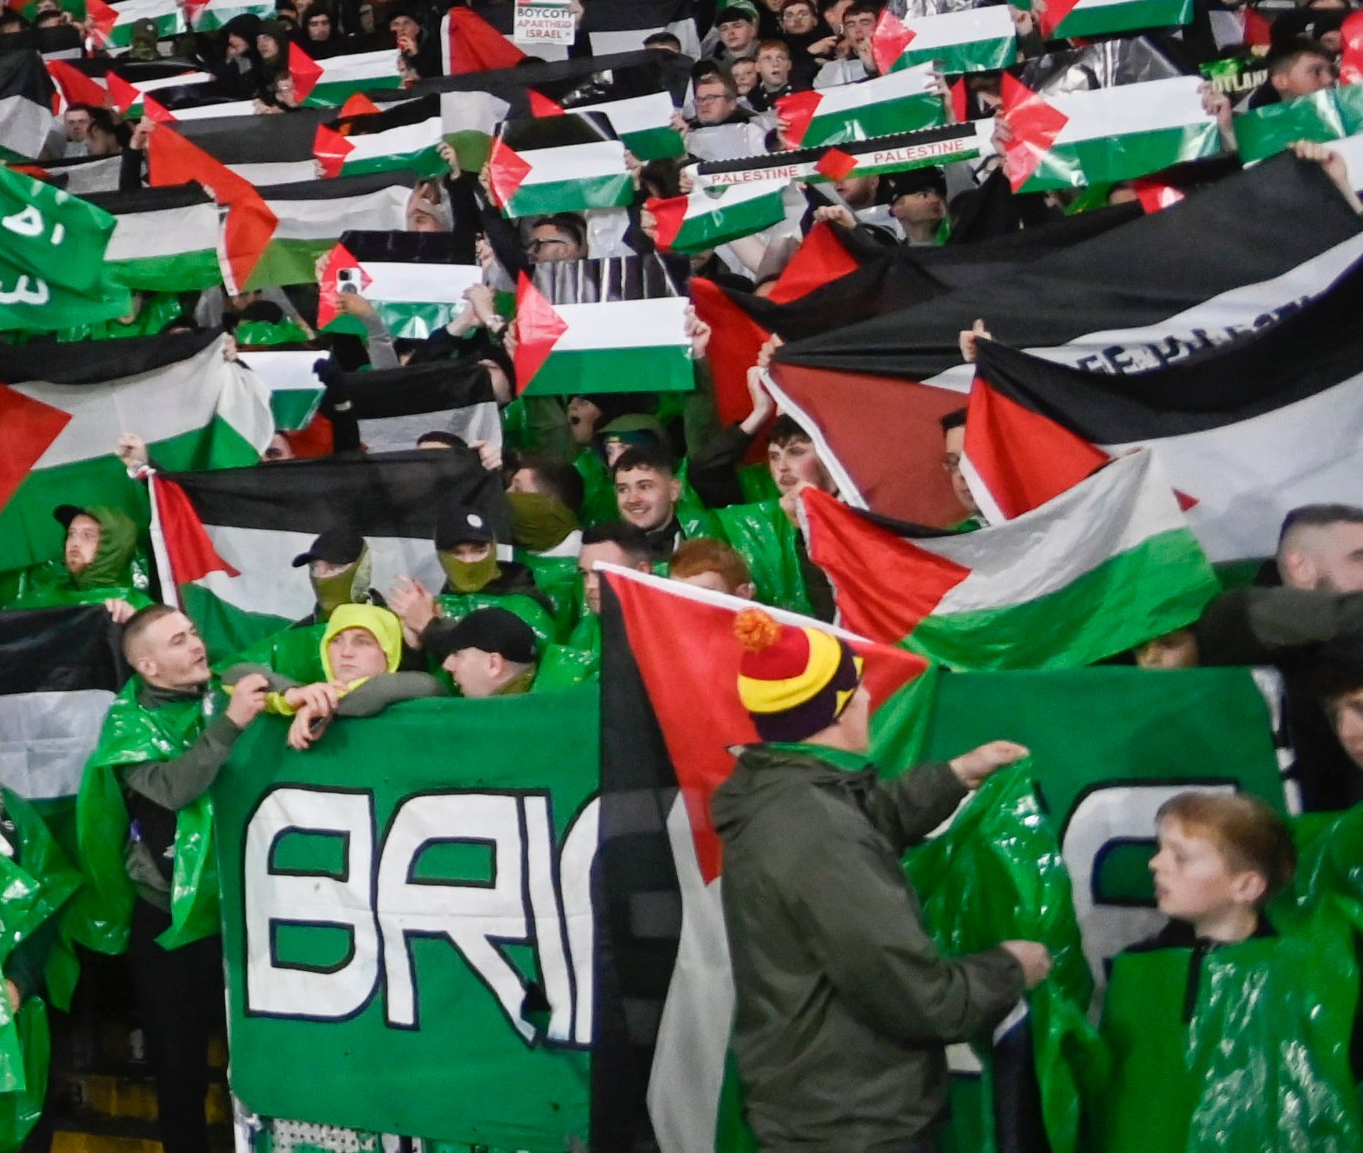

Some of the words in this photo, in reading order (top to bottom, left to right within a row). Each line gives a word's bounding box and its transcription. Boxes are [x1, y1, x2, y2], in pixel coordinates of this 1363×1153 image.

[517, 8, 573, 19] BOYCOTT
[517, 19, 573, 29] APARTHEID
[525, 29, 562, 39] ISRAEL
[711, 165, 799, 185] PALESTINE
[874, 139, 965, 165] PALESTINE
